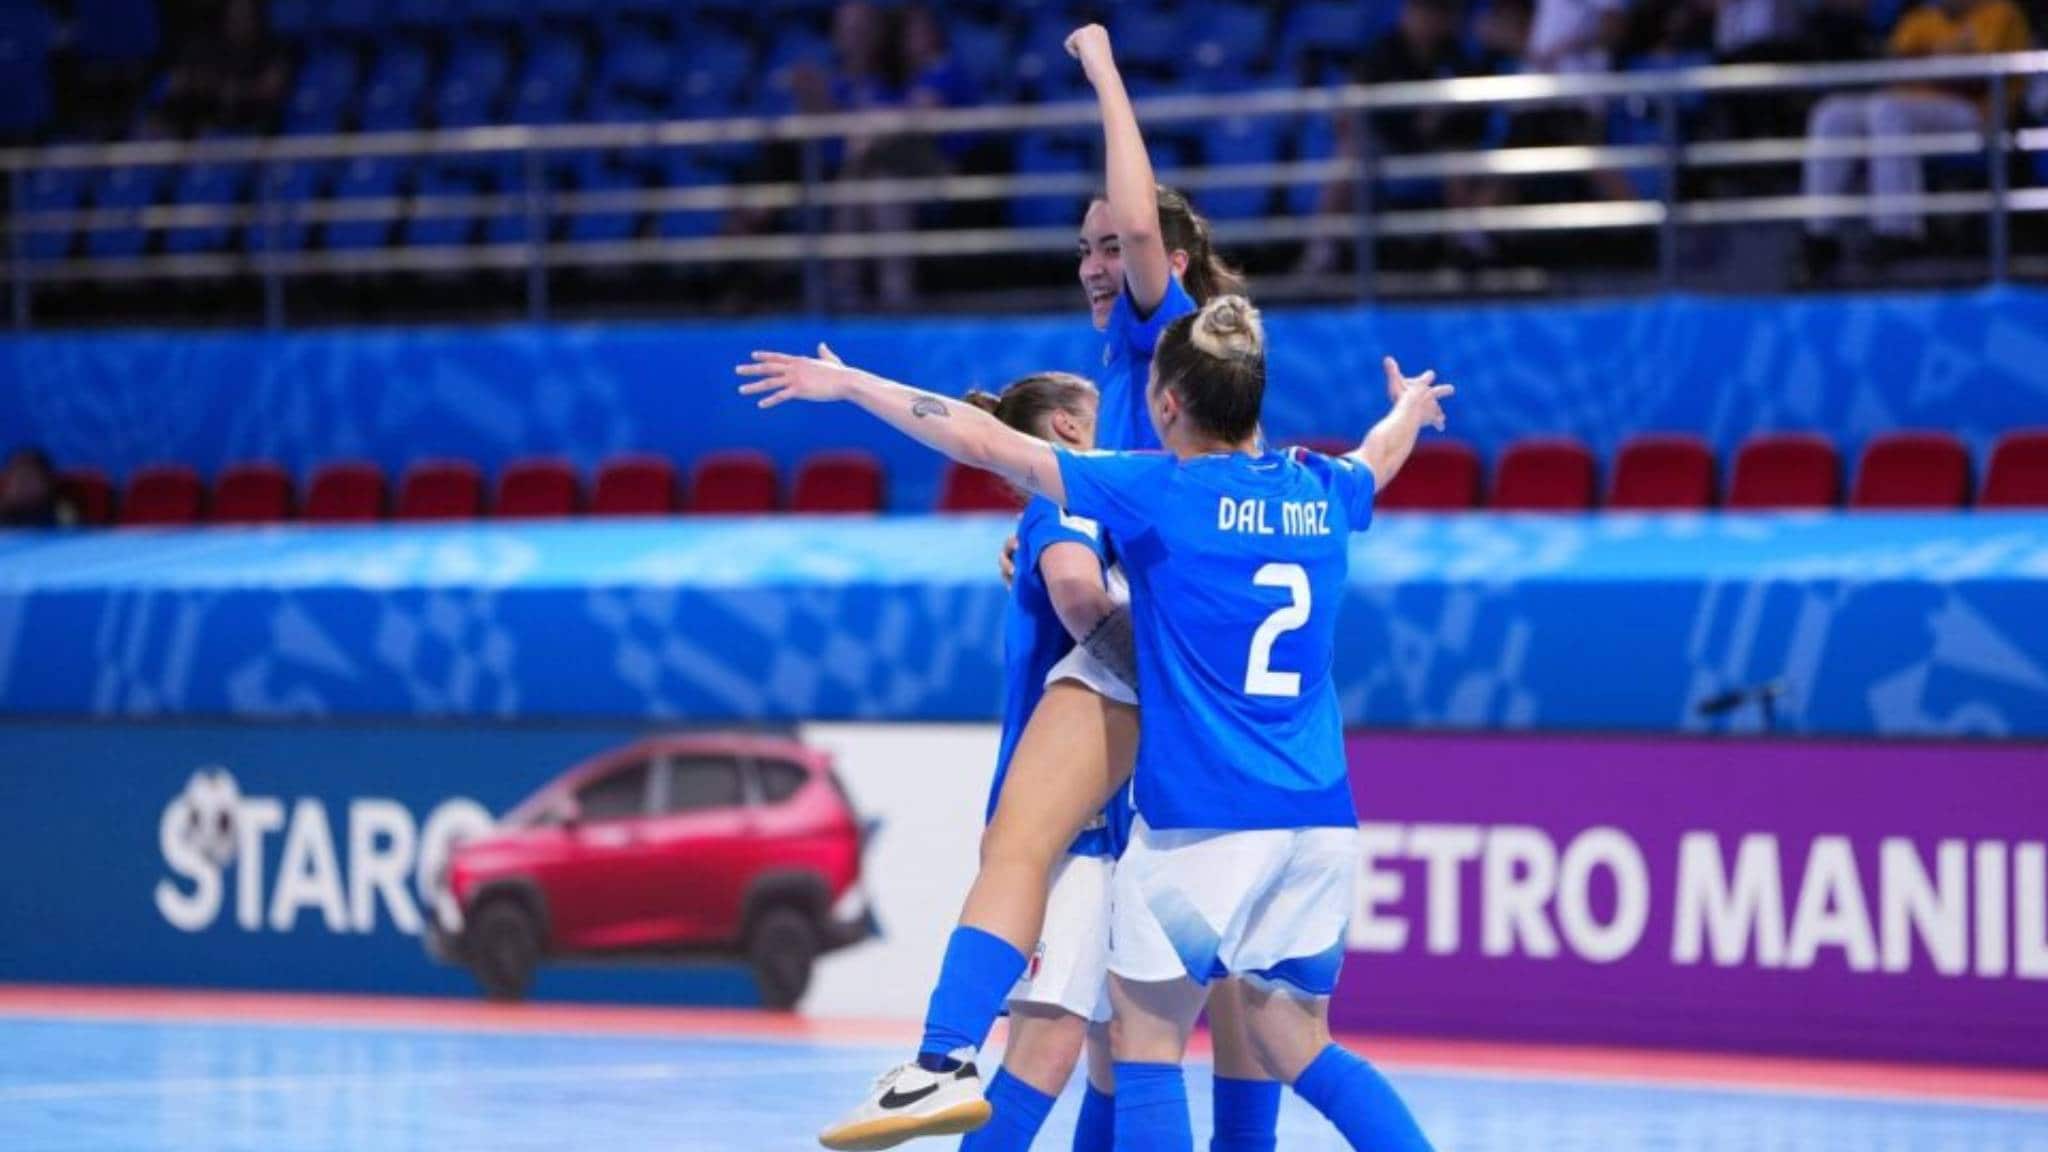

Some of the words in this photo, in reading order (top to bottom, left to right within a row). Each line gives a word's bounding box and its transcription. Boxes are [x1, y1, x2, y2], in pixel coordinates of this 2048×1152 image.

[1218, 496, 1275, 535] DAL
[1282, 500, 1331, 536] MAZ
[1244, 562, 1312, 697] 2
[1346, 822, 1651, 963] ETRO
